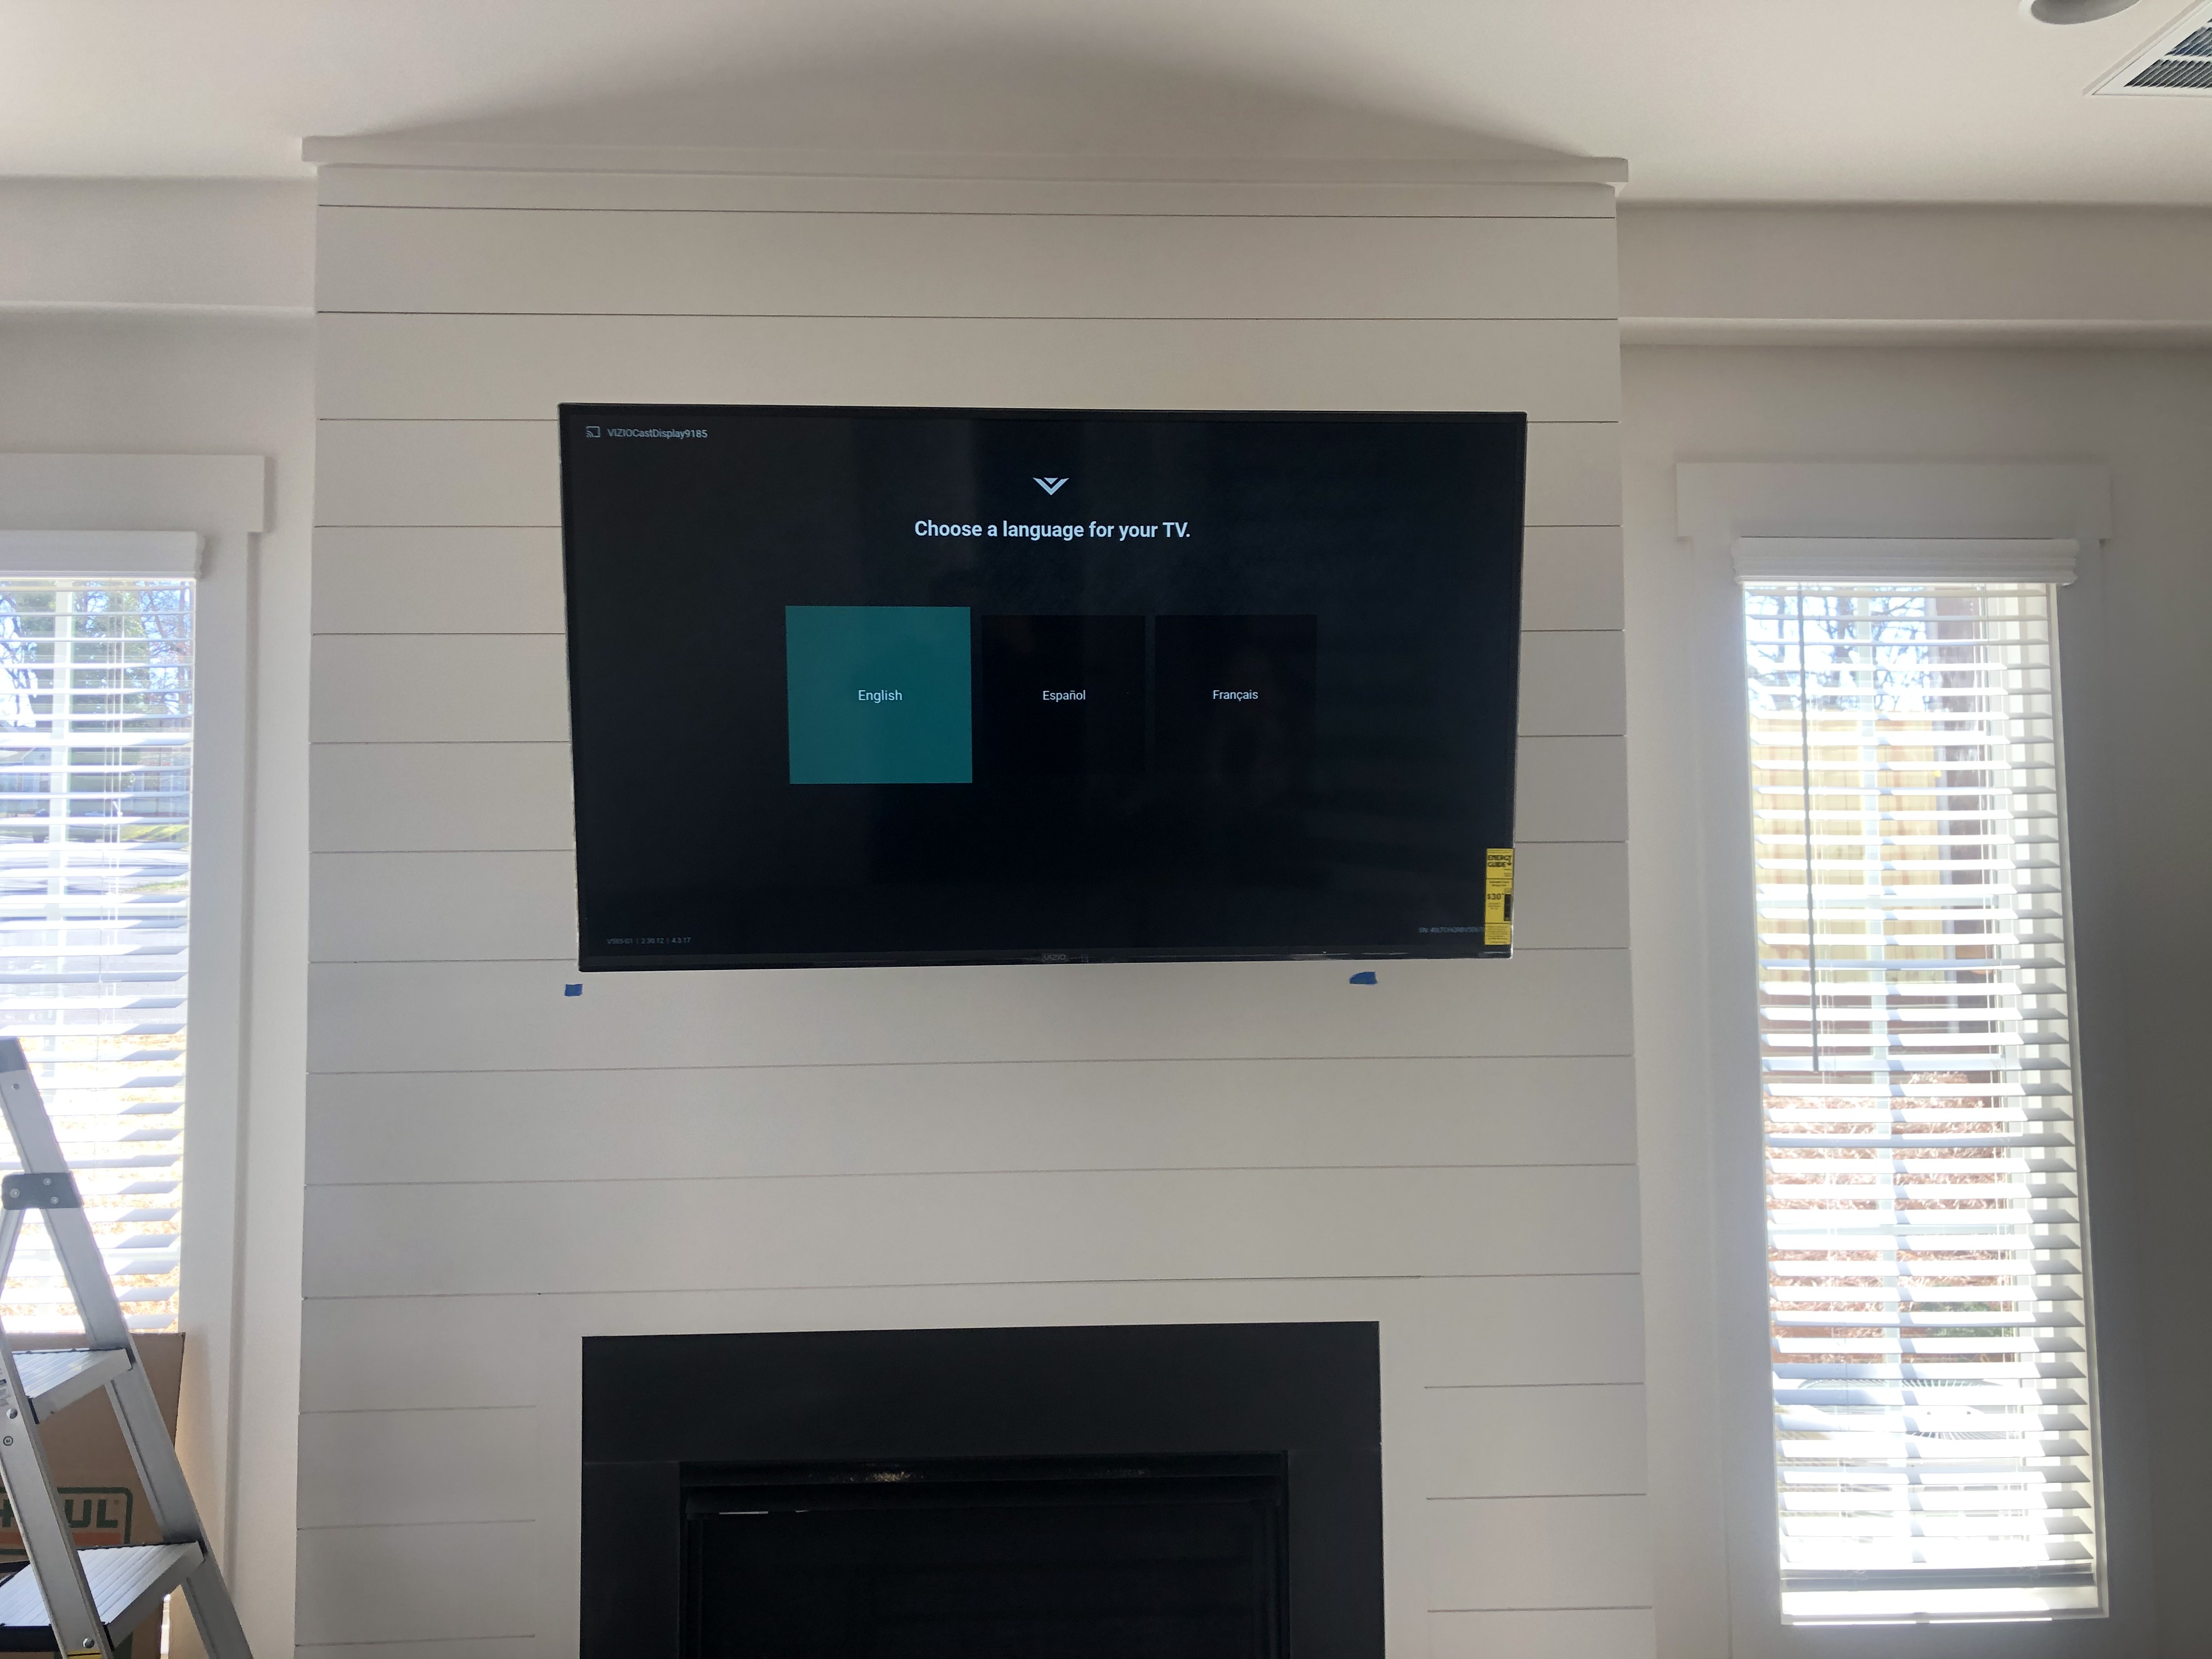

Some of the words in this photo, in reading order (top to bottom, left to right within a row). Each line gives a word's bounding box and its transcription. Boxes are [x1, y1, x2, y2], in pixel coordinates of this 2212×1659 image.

[607, 428, 708, 440] VIZIOCastDisplay9185
[915, 519, 983, 537] Choose
[987, 524, 998, 537] a
[1003, 520, 1084, 541] language
[1088, 521, 1115, 538] for
[1119, 525, 1158, 541] your
[1163, 521, 1190, 538] TV.
[858, 689, 902, 704] English
[1042, 689, 1086, 703] Español
[1213, 689, 1259, 702] Français
